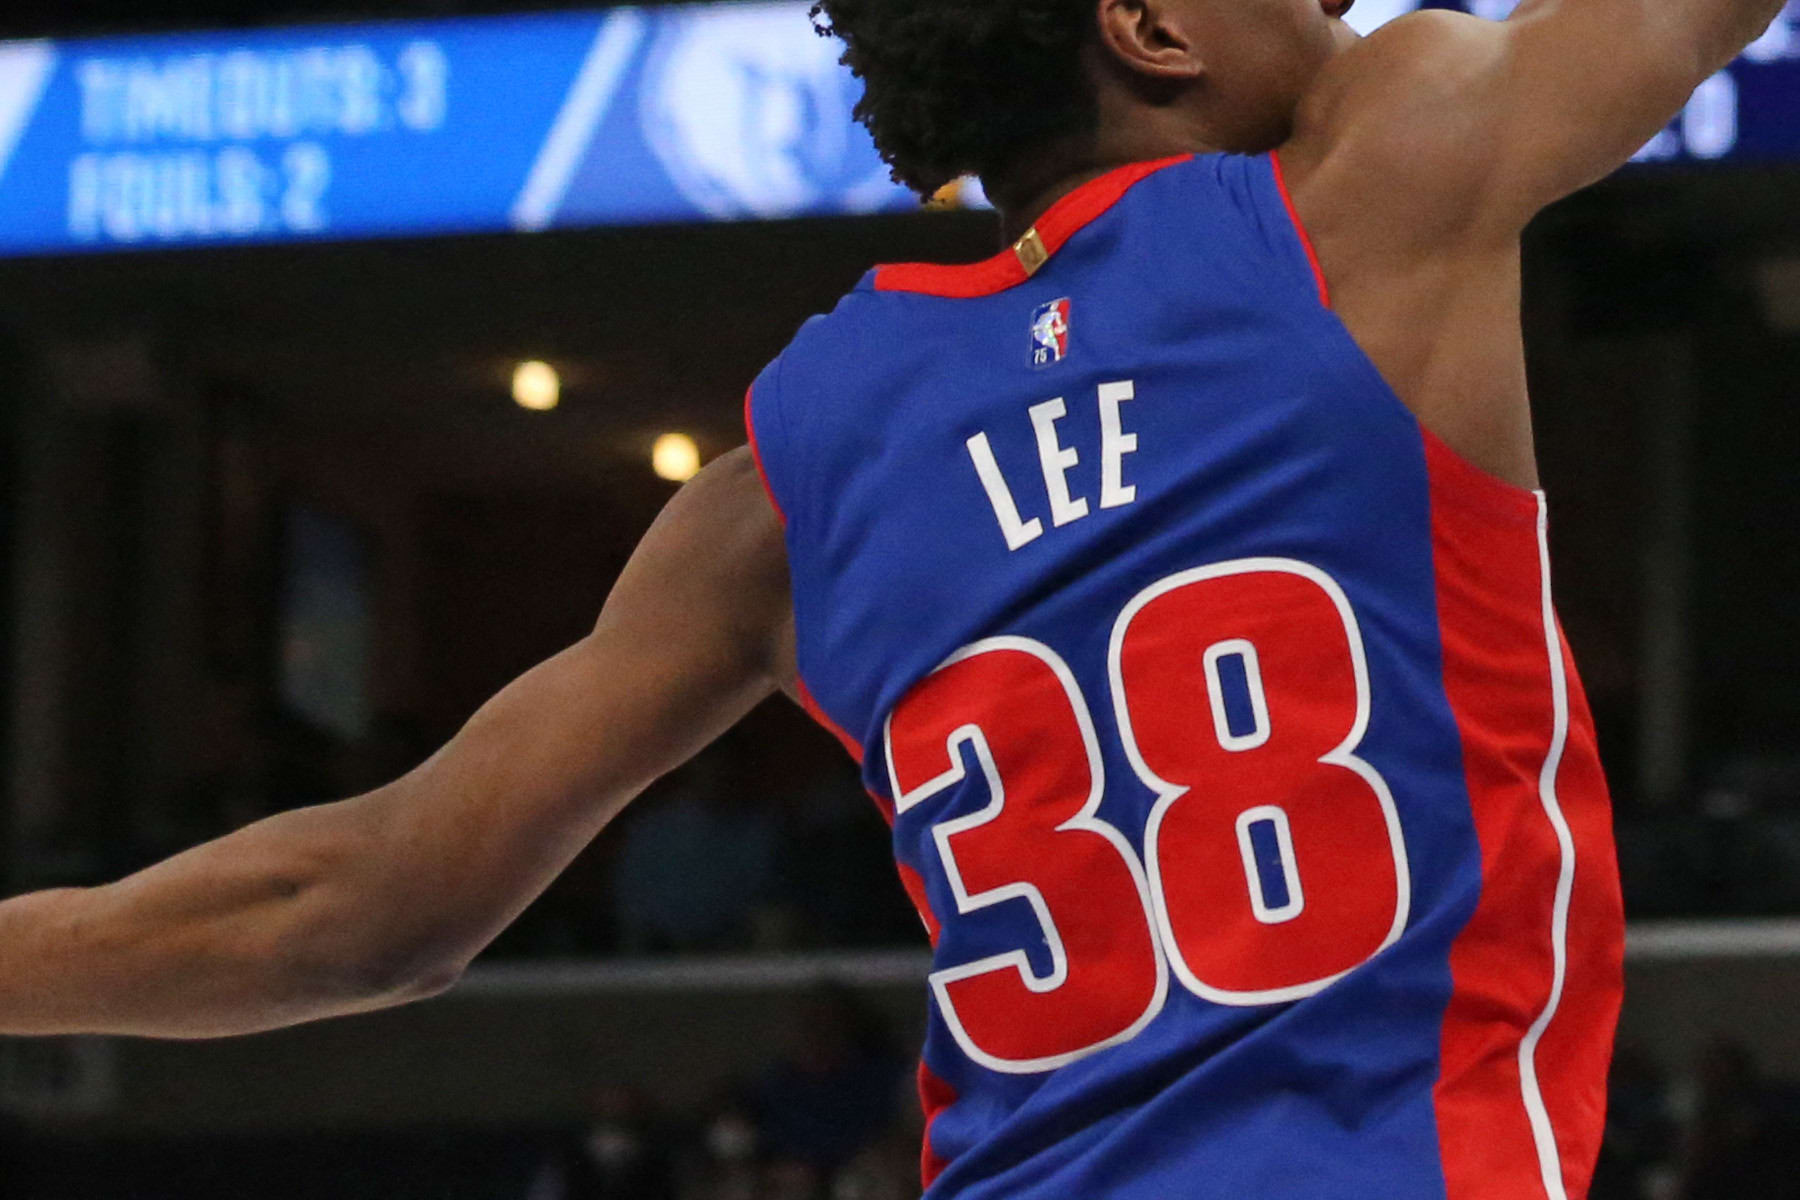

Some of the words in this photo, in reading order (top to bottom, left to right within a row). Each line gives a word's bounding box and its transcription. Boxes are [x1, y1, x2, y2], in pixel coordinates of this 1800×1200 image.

[77, 45, 396, 142] TIMEOUTS:
[68, 144, 277, 240] FOULS:
[281, 141, 331, 231] 2
[1033, 347, 1048, 365] 75
[966, 380, 1138, 552] LEE
[883, 557, 1411, 1074] 38
